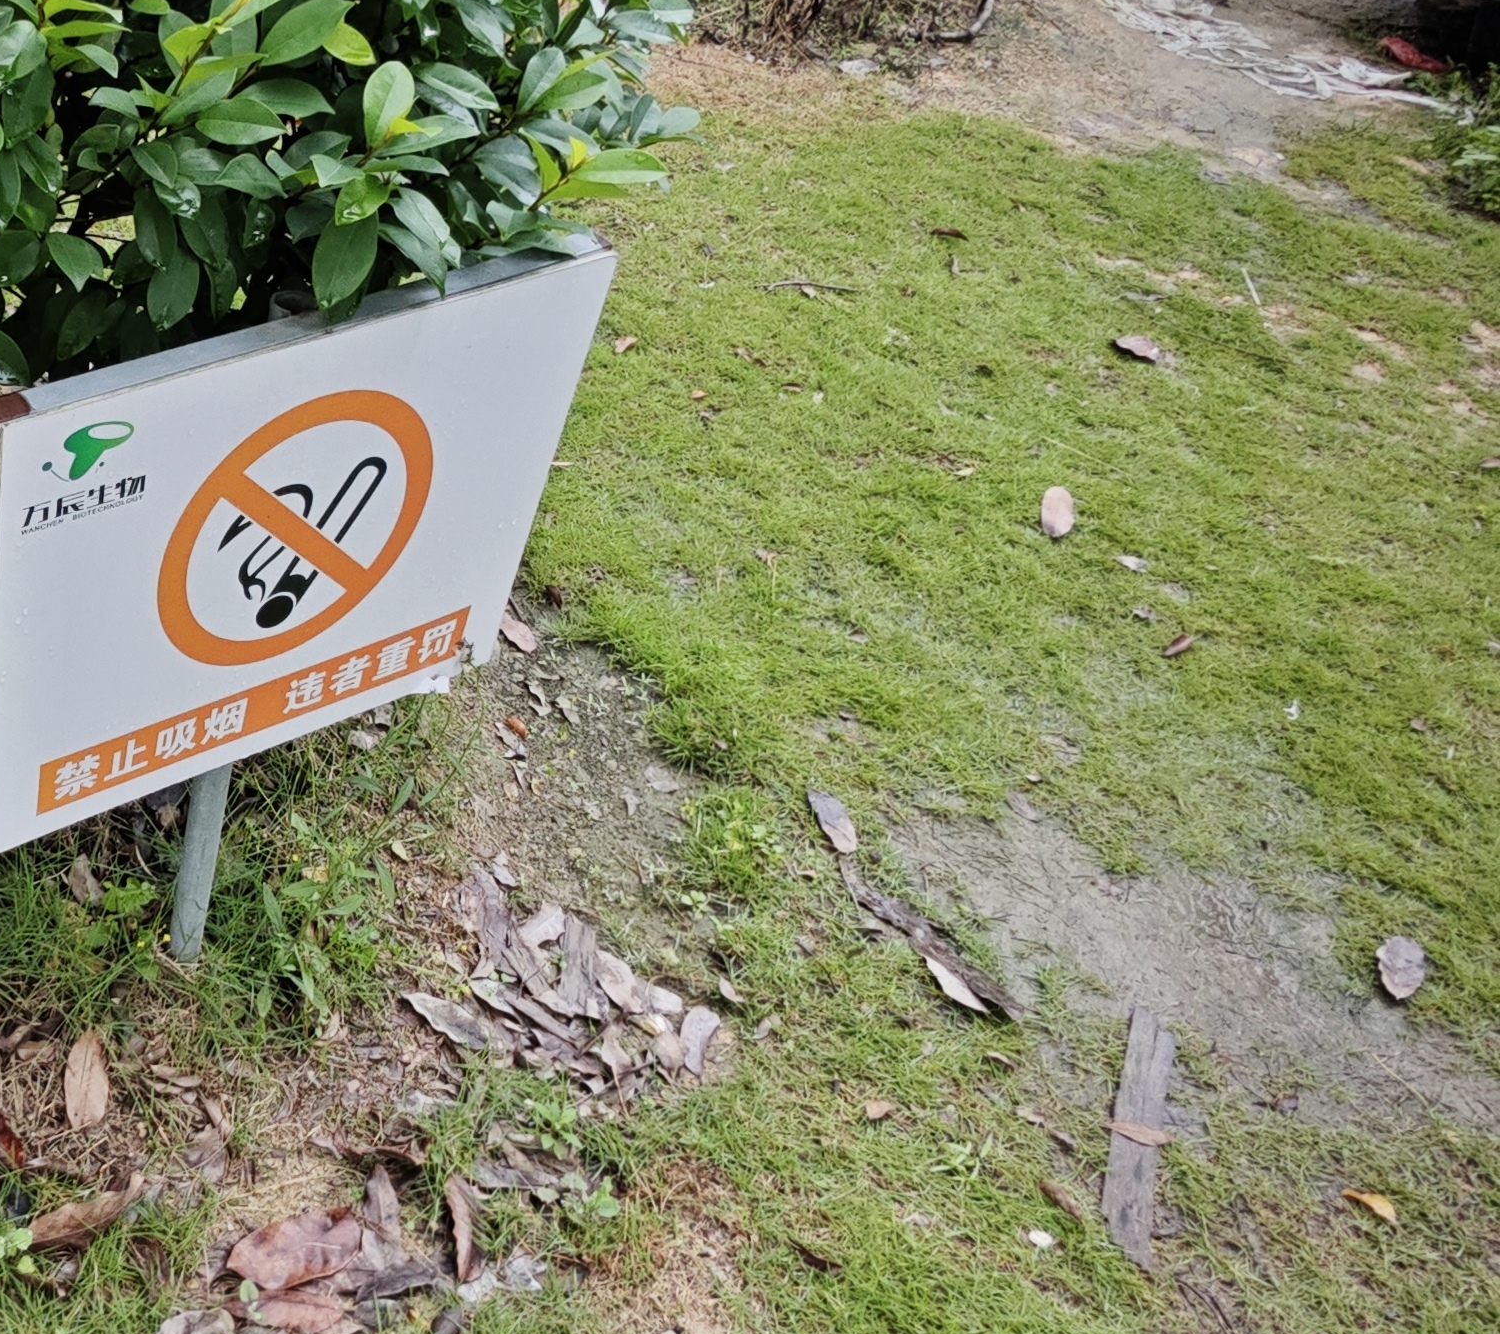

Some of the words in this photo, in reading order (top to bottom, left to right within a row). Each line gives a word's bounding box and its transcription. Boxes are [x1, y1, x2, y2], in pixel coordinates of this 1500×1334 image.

[21, 475, 146, 528] 万辰生物
[21, 518, 64, 535] WANCHEN
[72, 494, 144, 521] BIOTECHNOLOGY
[54, 698, 248, 800] 禁止吸烟
[283, 619, 458, 715] 违者重罚
